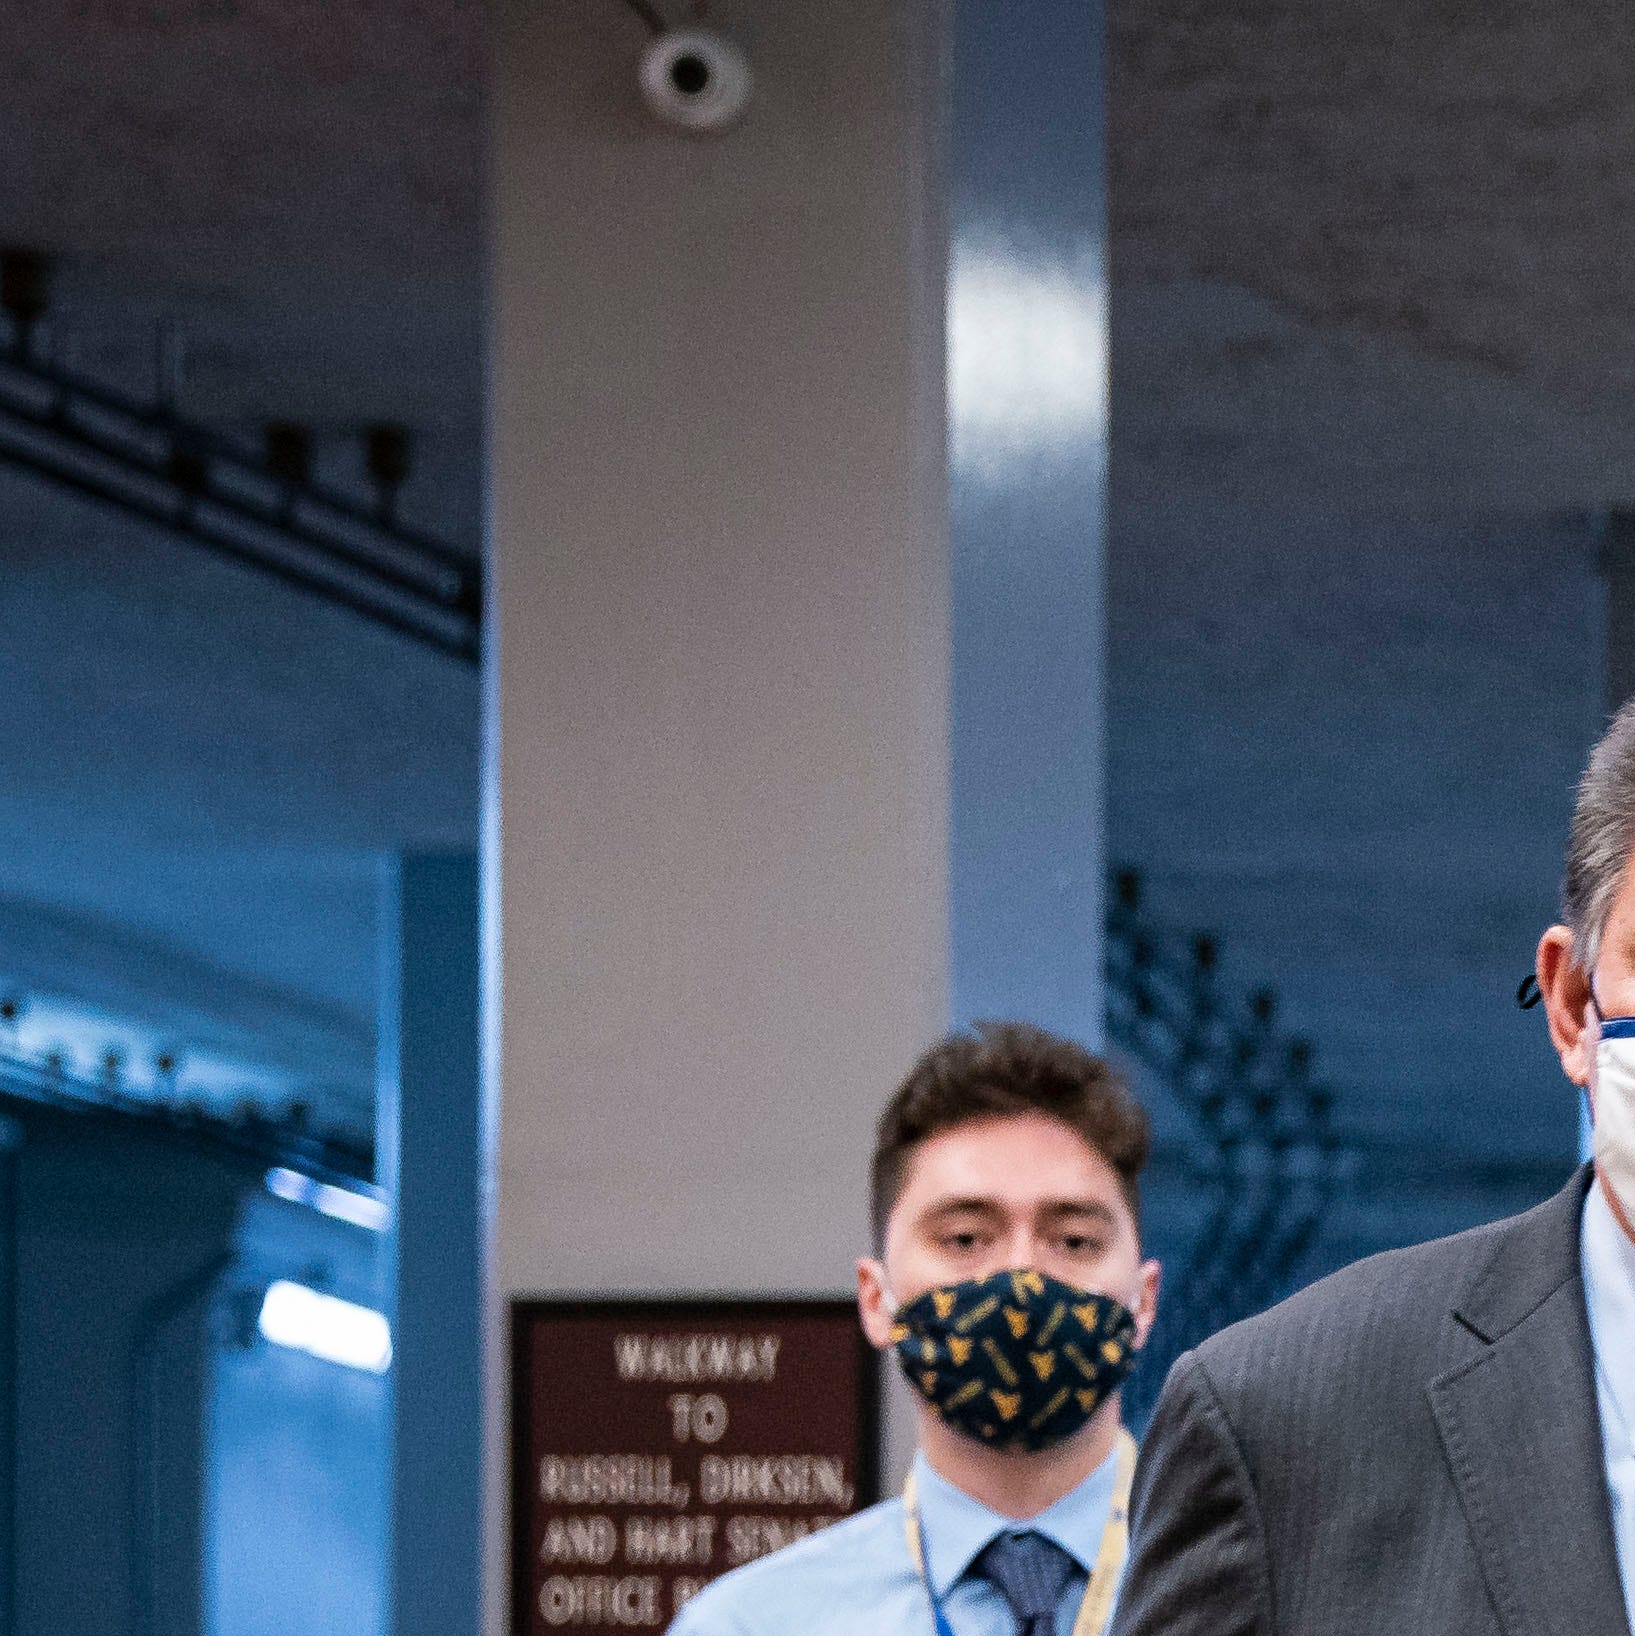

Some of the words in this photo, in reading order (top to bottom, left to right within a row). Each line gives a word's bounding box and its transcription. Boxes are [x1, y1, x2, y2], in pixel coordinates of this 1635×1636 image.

[614, 1334, 781, 1382] WALKWAY
[668, 1394, 729, 1443] TO
[540, 1455, 690, 1509] RUSSELL,
[540, 1515, 618, 1563] AND
[624, 1515, 718, 1563] HART
[538, 1575, 662, 1625] OFFICE
